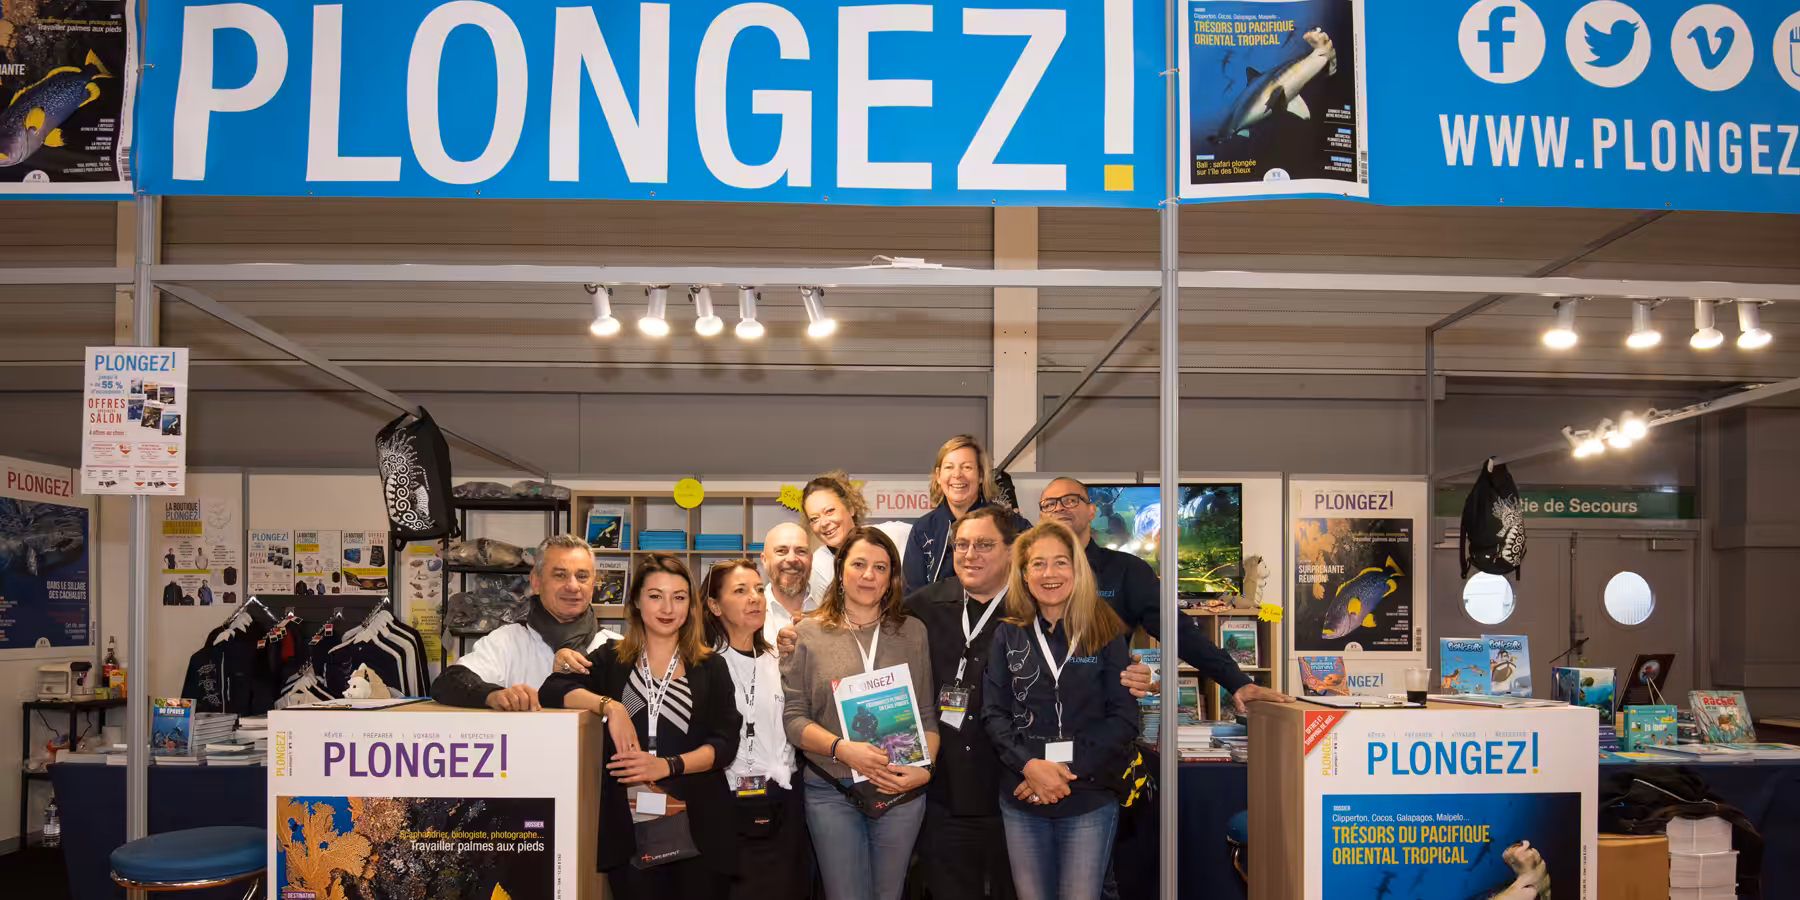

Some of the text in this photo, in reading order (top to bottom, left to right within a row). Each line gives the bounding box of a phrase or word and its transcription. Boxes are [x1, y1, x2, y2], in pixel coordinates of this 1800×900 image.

[1194, 20, 1294, 33] TRÉSORS DU PACIFIQUE
[1194, 34, 1280, 46] ORIENTAL TROPICAL
[172, 0, 1134, 191] PLONGEZ!
[1439, 113, 1800, 176] WWW.PLONGEZ
[94, 352, 175, 371] PLONGEZ!
[88, 398, 125, 408] OFFRES
[90, 413, 121, 423] SALON
[8, 468, 73, 497] PLONGEZ!
[877, 494, 936, 510] PLONG
[1315, 490, 1393, 510] PLONGEZ!
[1520, 498, 1637, 513] tie de Secours
[166, 503, 198, 511] LA BOUTIQUE
[1299, 565, 1344, 574] SURPRENANTE
[1299, 574, 1327, 583] RÉUNION
[47, 581, 86, 590] DANS LE SILLAGE
[49, 591, 86, 600] DES CACHALOTS
[1348, 673, 1383, 687] NGEZ!
[324, 734, 507, 778] PLONGEZ!
[1368, 732, 1538, 775] PLONGEZ!
[1332, 814, 1370, 823] Clipperton,
[1371, 814, 1395, 823] Cocos,
[1396, 813, 1434, 823] Galapagos,
[452, 830, 489, 841] biologiste,
[1332, 824, 1490, 844] TRÉSORS DU PACIFIQUE
[410, 840, 545, 853] Travailler palmes aux pieds
[1332, 846, 1468, 865] ORIENTAL TROPICAL
